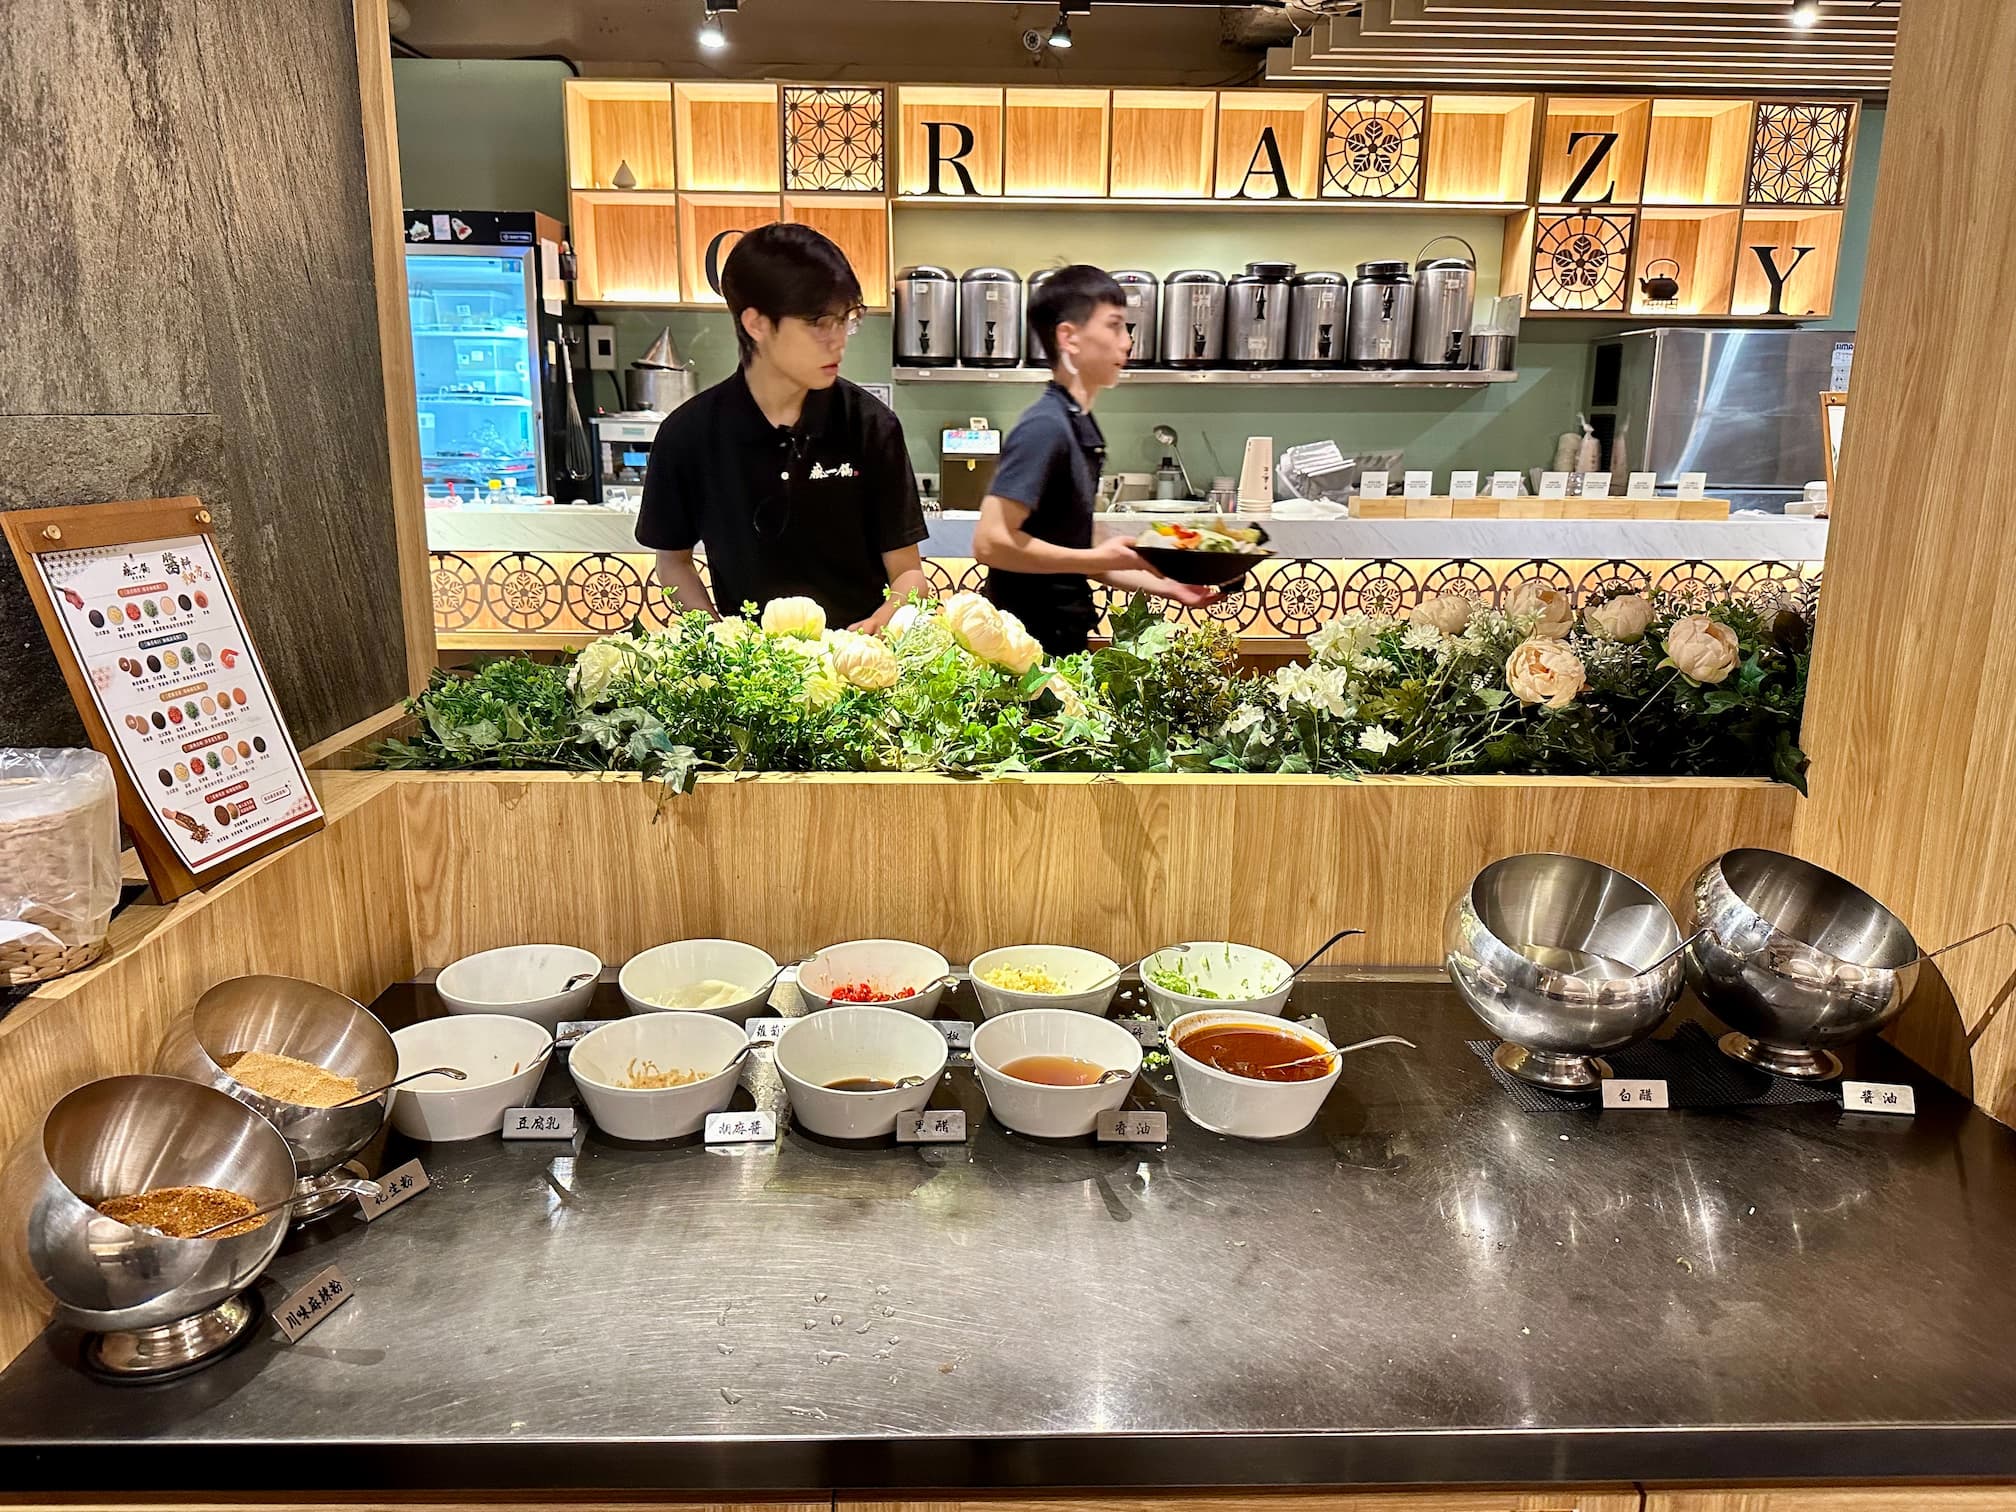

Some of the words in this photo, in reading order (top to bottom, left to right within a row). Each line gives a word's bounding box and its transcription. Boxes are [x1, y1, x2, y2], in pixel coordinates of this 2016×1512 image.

[920, 121, 981, 197] R
[1230, 126, 1299, 199] A
[1560, 132, 1619, 203] Z
[1749, 246, 1816, 315] Y
[1618, 1088, 1653, 1102] 白醋
[1860, 1089, 1898, 1104] 醬油
[515, 1115, 560, 1131] 豆腐乳
[1115, 1120, 1151, 1136] 香油
[285, 1279, 343, 1329] 川味麻辣粉
